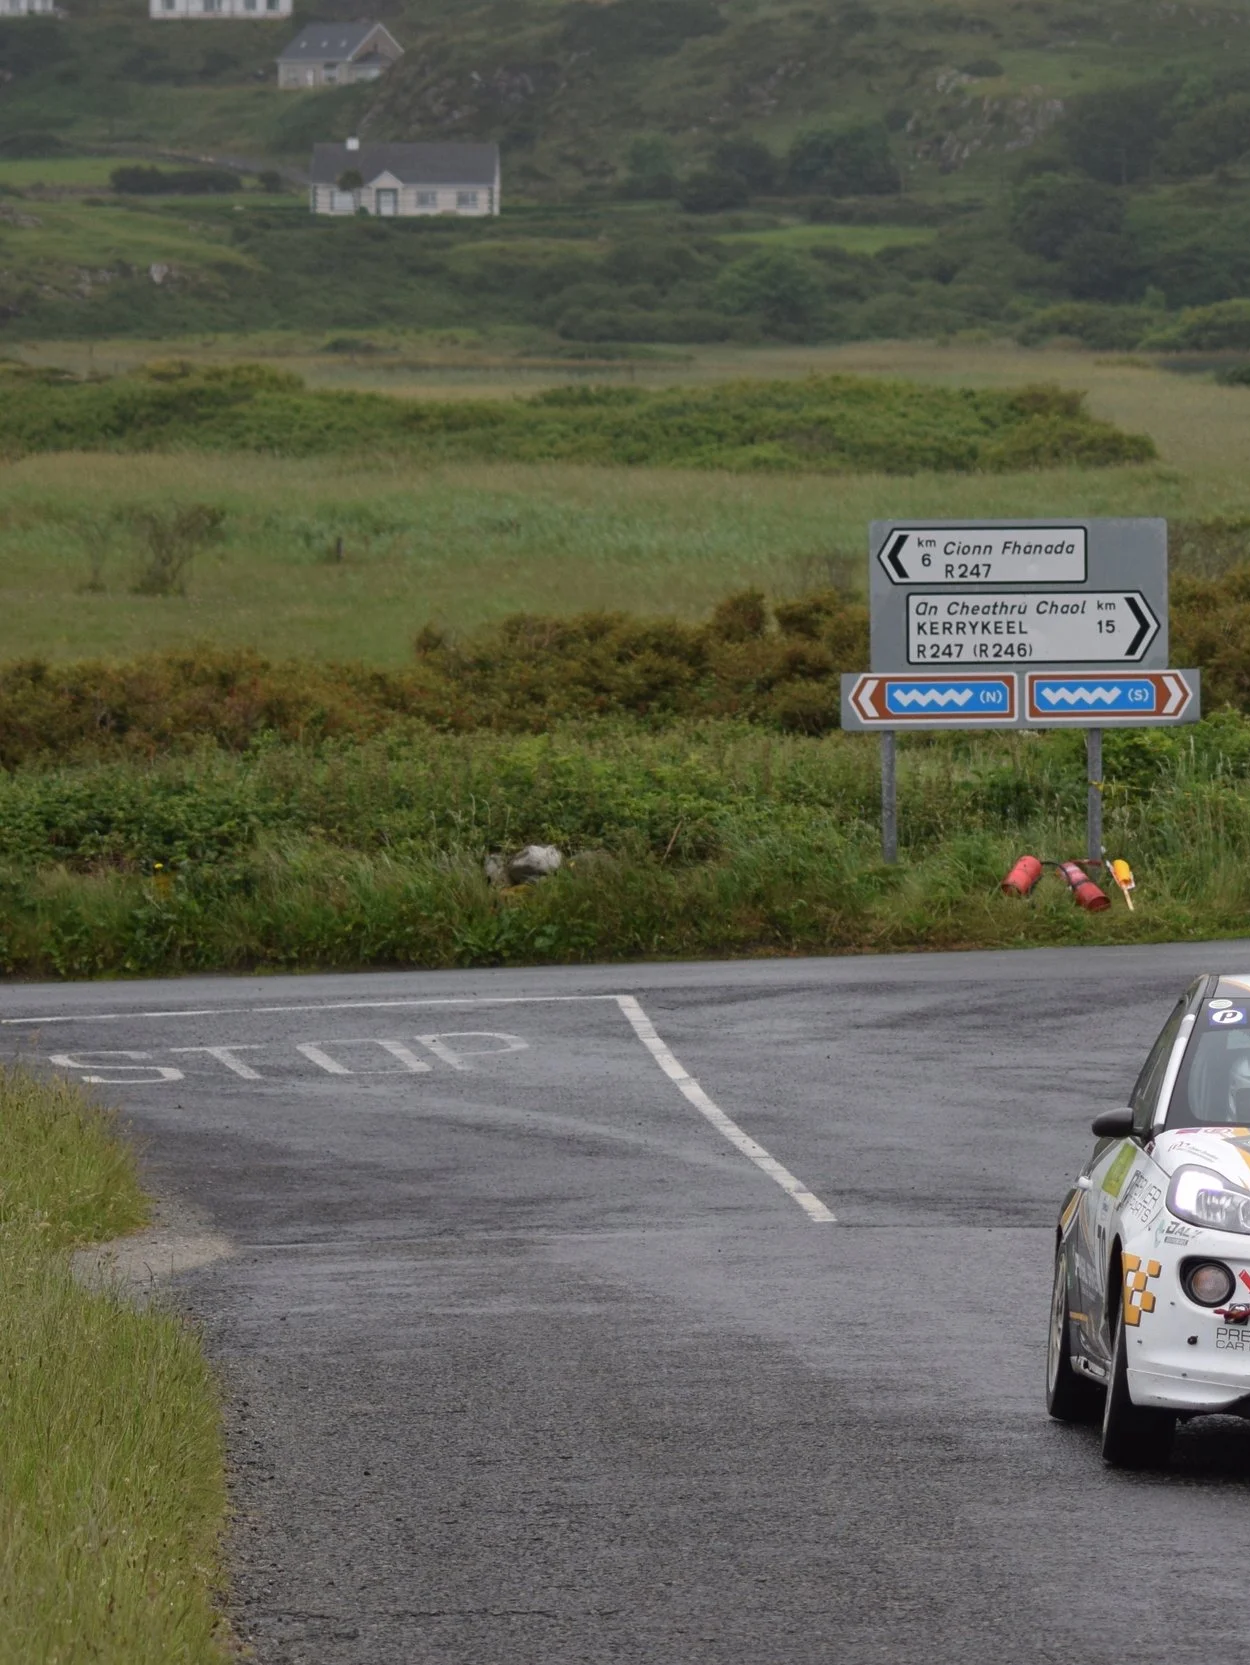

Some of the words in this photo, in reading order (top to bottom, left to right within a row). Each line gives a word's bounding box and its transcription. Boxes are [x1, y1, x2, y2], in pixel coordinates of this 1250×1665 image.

[917, 537, 936, 548] km
[943, 541, 993, 556] Cionn
[921, 553, 932, 567] 6
[944, 563, 992, 579] R247
[1035, 600, 1086, 614] Chaol
[1096, 600, 1116, 611] km
[917, 621, 1028, 635] KERRYKEEL
[1097, 619, 1116, 634] 15
[916, 643, 964, 658] R247
[980, 690, 1002, 704] (N)
[1128, 688, 1149, 703] (S)
[49, 1031, 530, 1084] STOP
[1216, 1340, 1244, 1351] CAR
